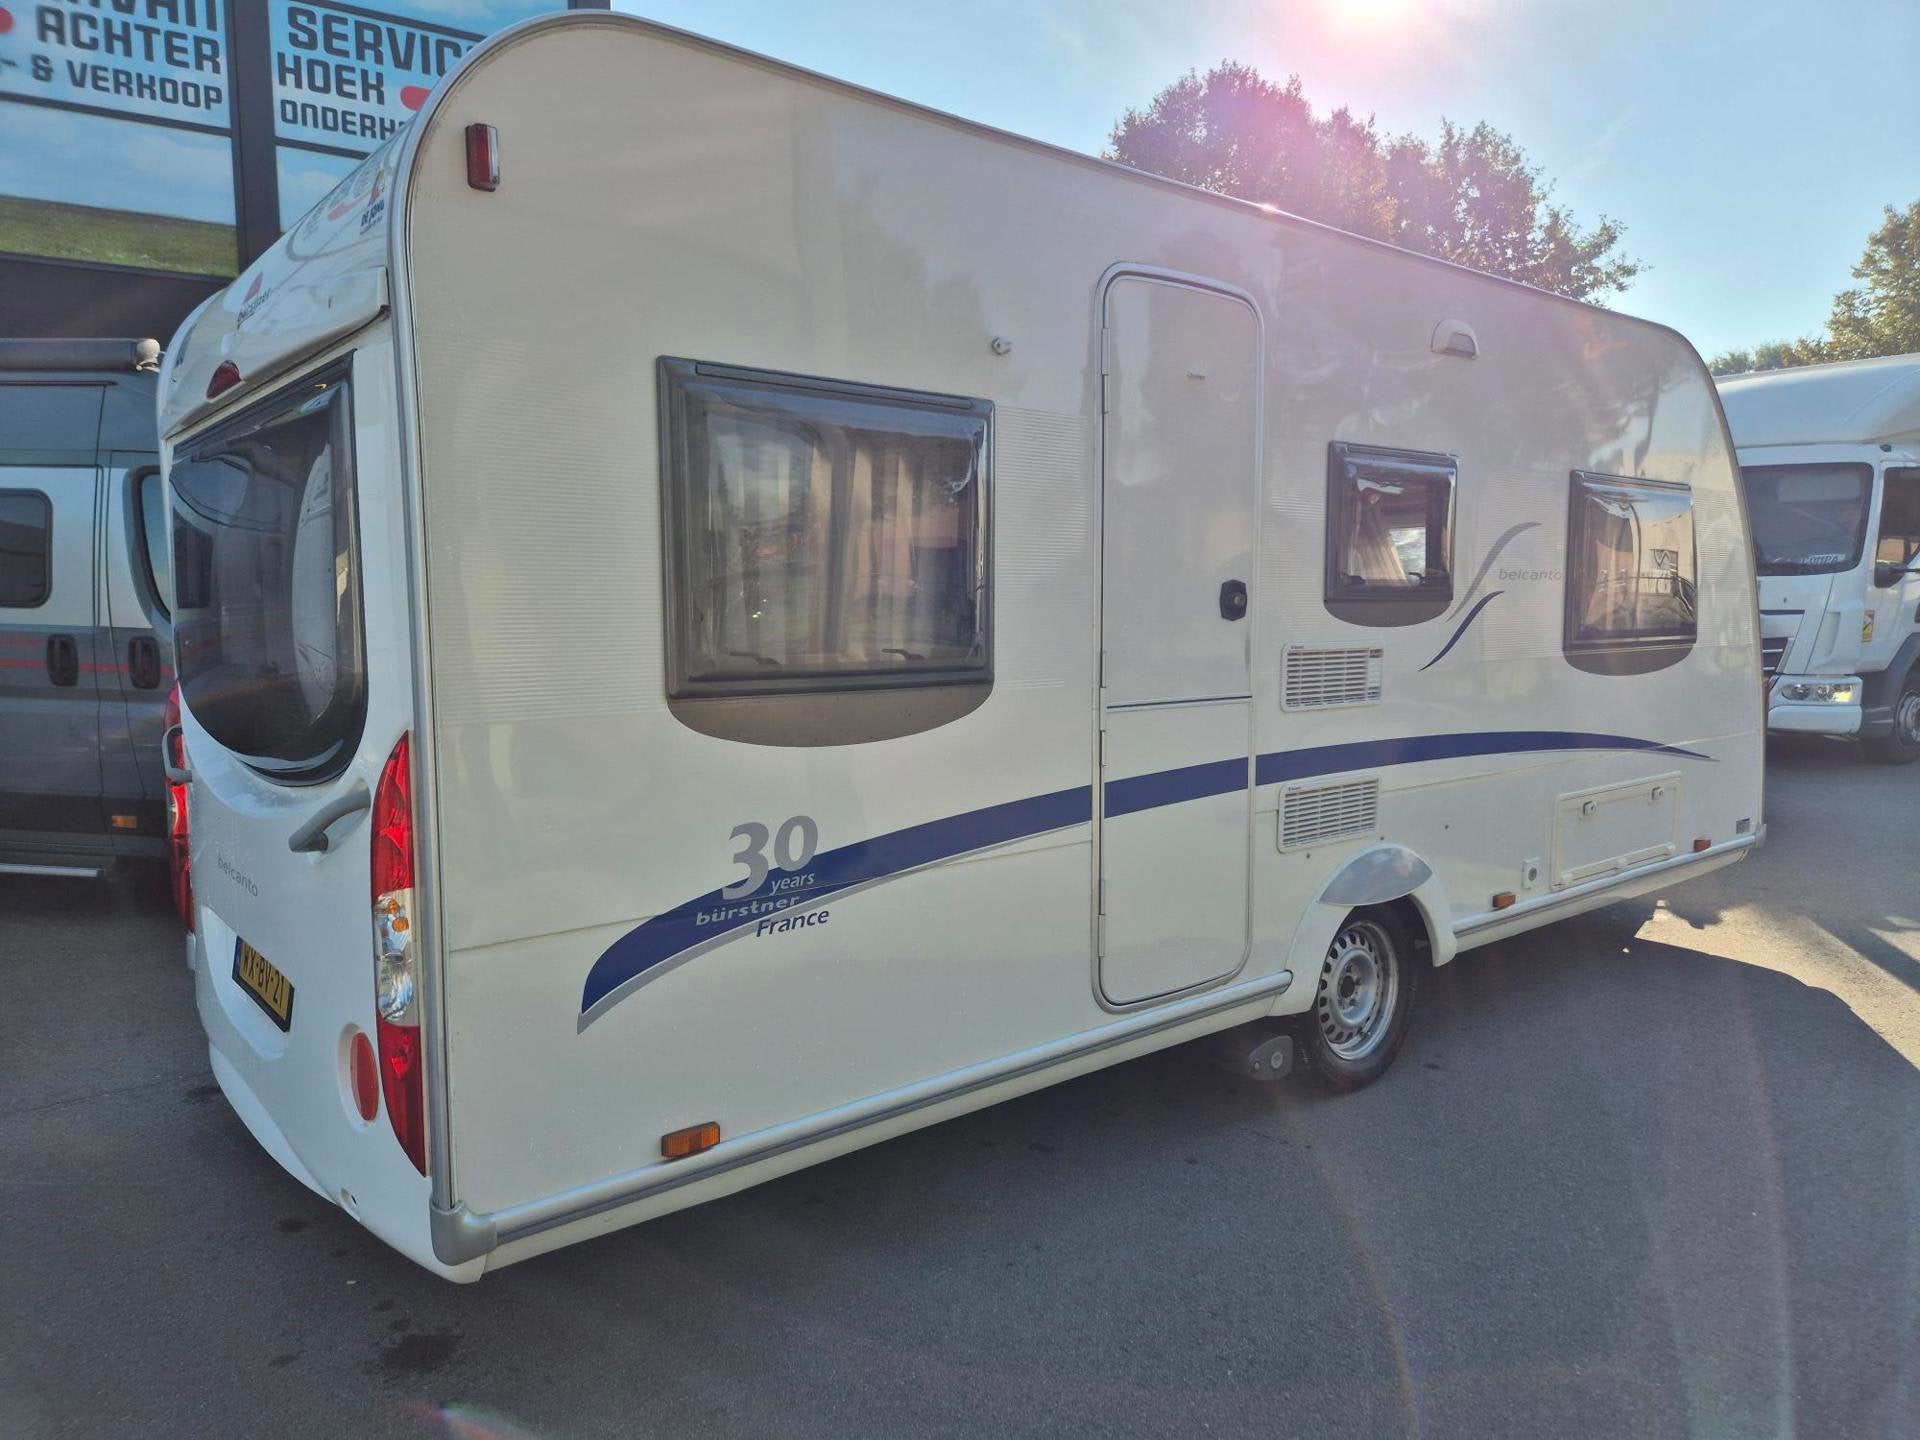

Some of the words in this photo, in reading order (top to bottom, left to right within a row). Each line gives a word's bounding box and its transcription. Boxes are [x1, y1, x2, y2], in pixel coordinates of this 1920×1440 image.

[36, 5, 221, 75] ACHTER
[288, 6, 474, 78] SERVIC
[31, 53, 54, 82] &
[66, 59, 223, 111] VERKOOP
[277, 52, 385, 106] HOEK
[280, 99, 405, 141] ONDERH
[1499, 567, 1562, 581] belcanto
[217, 853, 259, 897] belcanto
[722, 815, 819, 900] 30
[770, 872, 815, 896] years
[695, 895, 801, 926] bürstner
[756, 910, 830, 938] France
